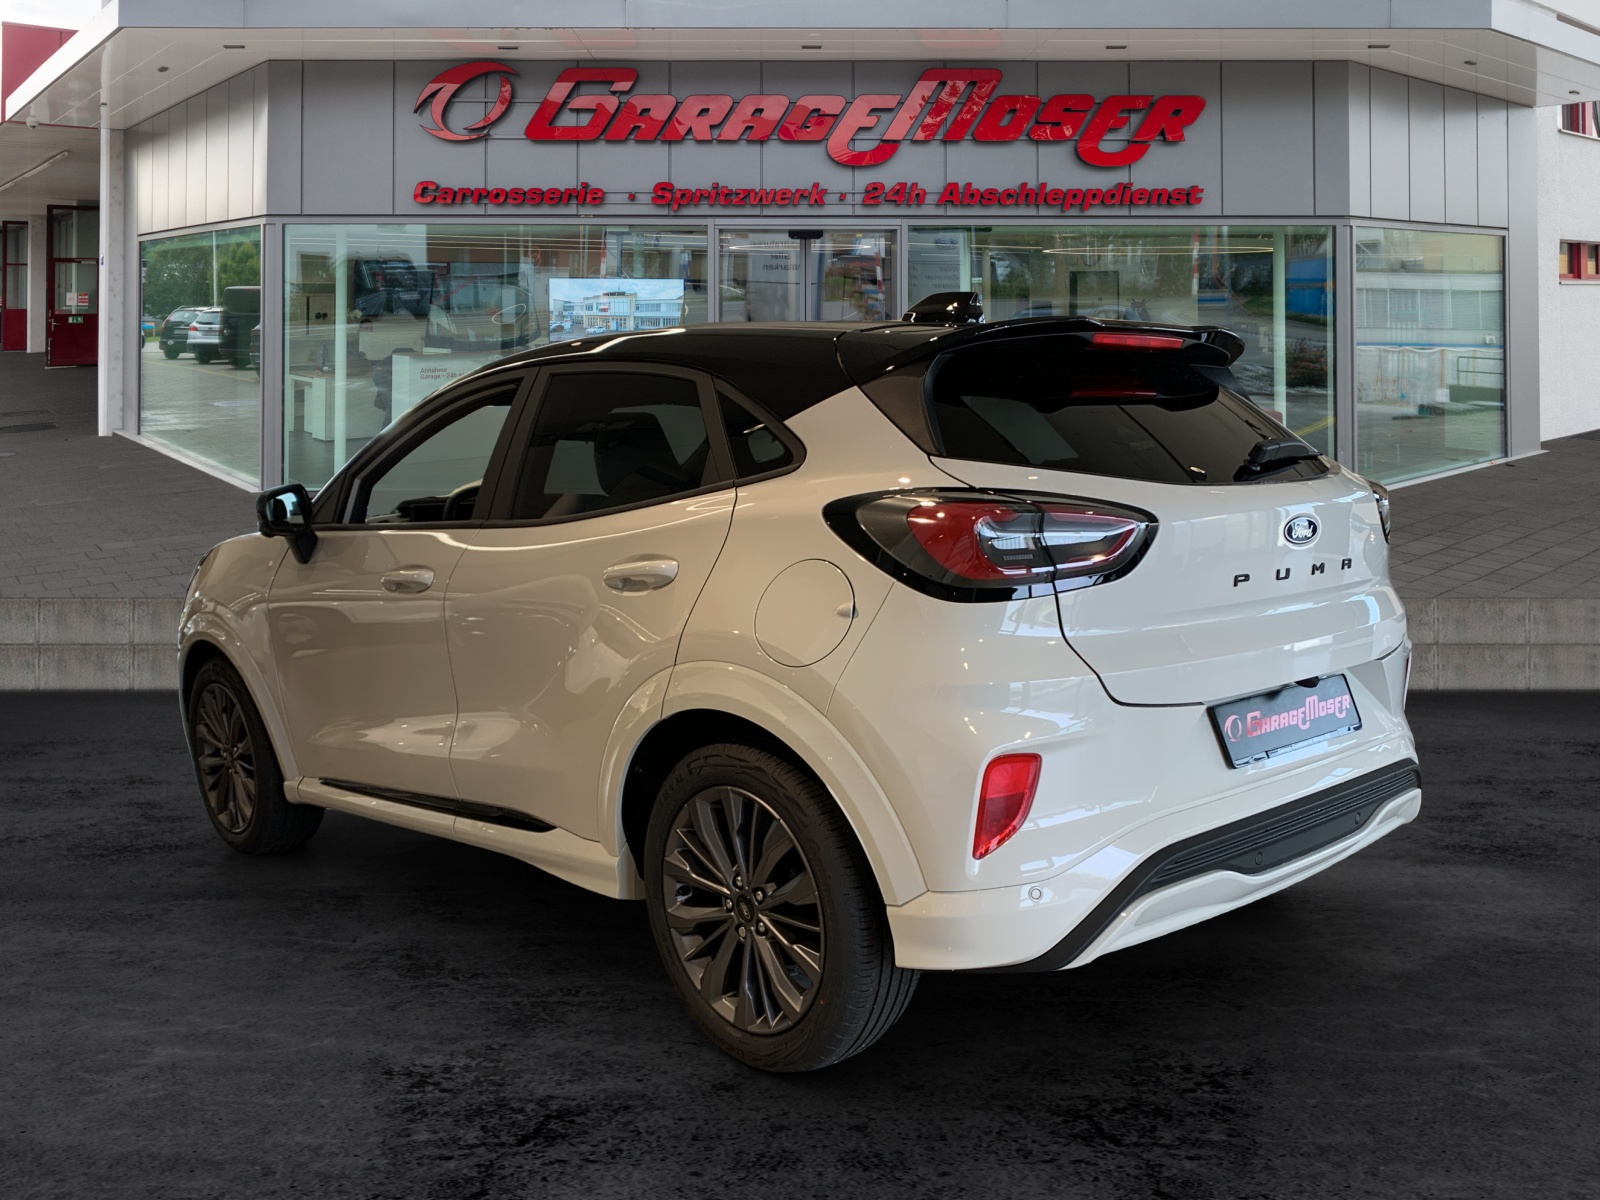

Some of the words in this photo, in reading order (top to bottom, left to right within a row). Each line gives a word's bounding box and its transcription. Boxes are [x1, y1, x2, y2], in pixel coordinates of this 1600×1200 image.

[413, 181, 605, 206] Carrosserie
[651, 181, 826, 212] Spritzwerk
[862, 182, 927, 206] 24h
[937, 181, 1204, 212] Abschleppdienst
[1233, 558, 1353, 587] PUMA
